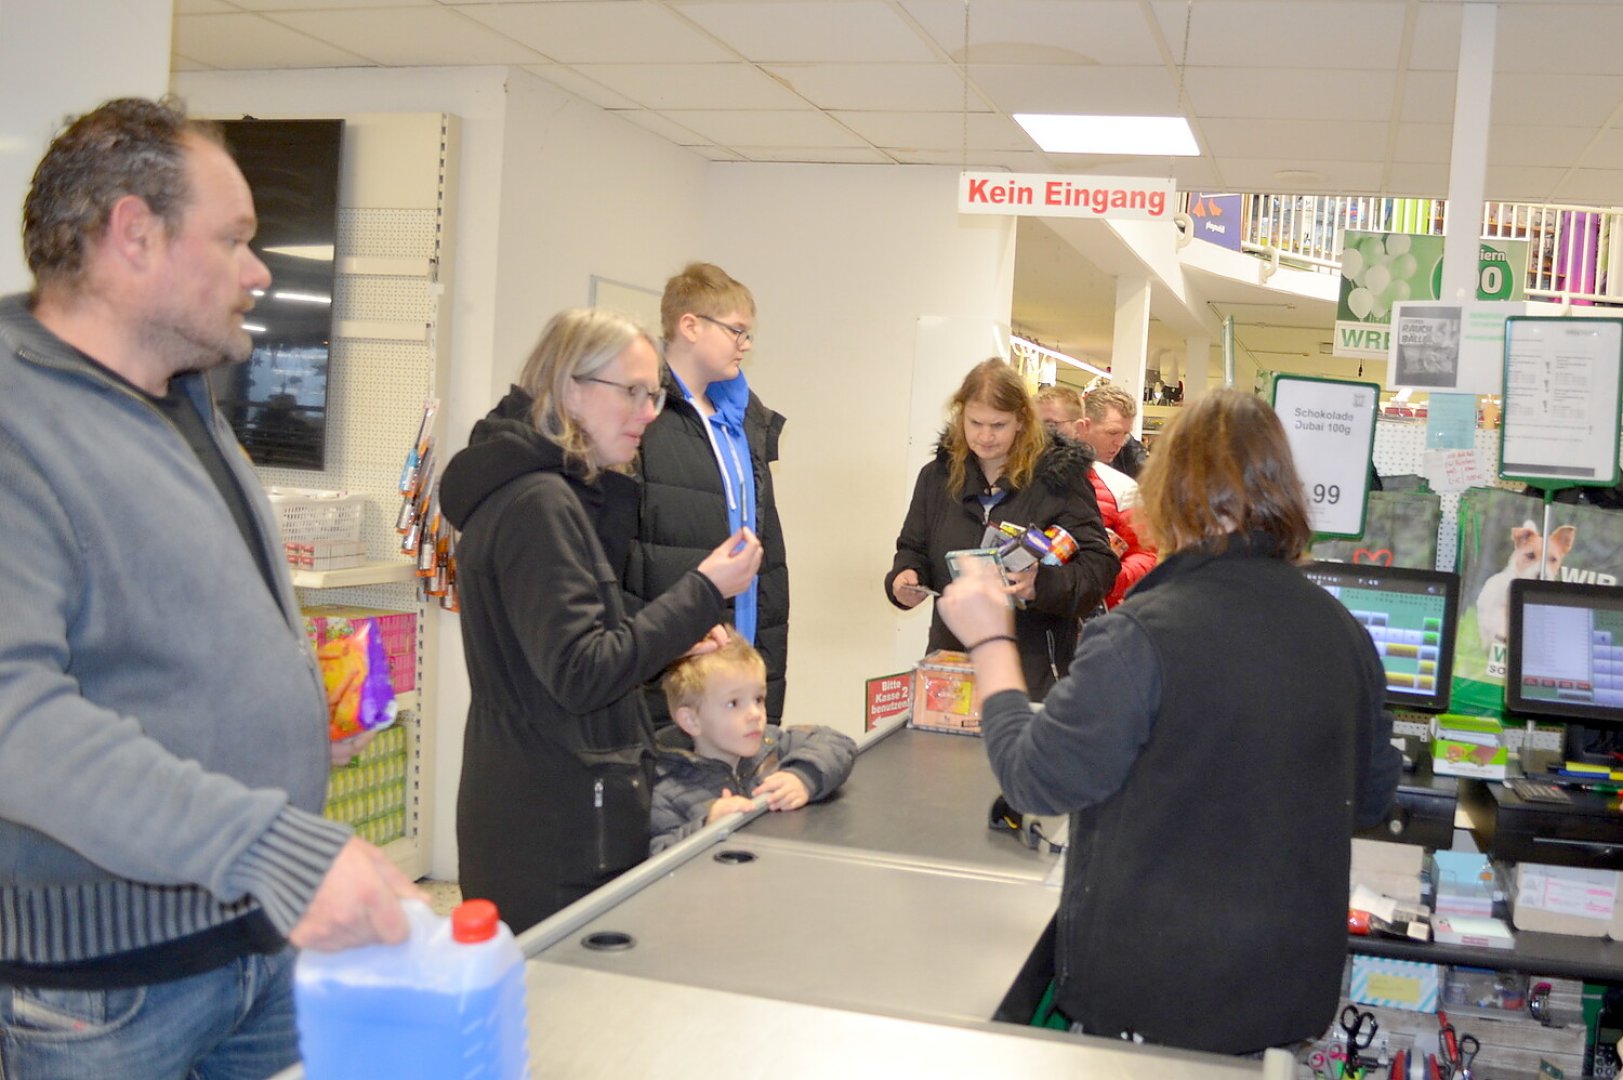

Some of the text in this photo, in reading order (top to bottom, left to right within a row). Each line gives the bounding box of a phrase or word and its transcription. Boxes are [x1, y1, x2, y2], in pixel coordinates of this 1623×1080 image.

[968, 179, 1165, 216] Kein Eingang
[1478, 266, 1503, 294] 0
[1295, 420, 1351, 436] Dubai 100g
[881, 680, 901, 691] Bitte
[875, 686, 908, 703] Kasse 2
